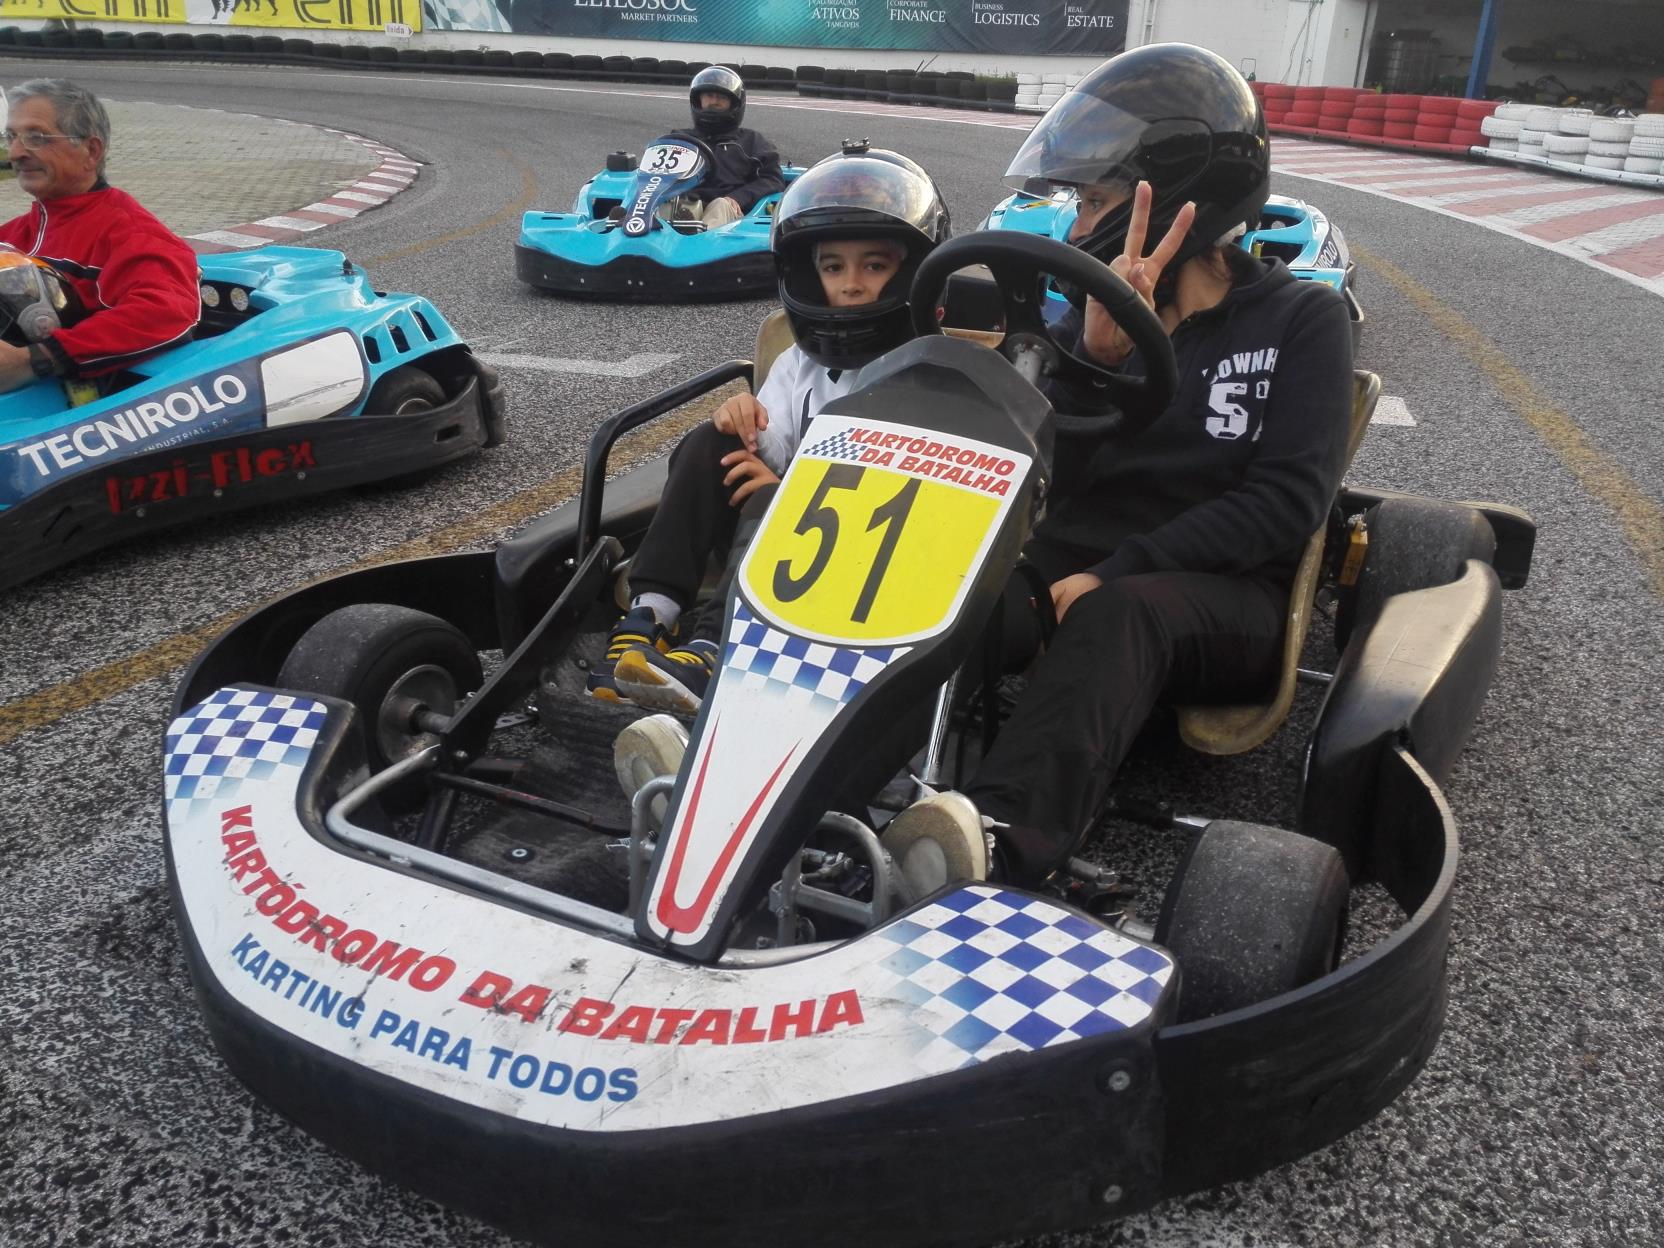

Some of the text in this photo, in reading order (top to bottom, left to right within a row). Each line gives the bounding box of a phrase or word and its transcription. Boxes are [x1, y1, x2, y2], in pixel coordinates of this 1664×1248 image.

[621, 12, 698, 23] MARKET PARTNERS
[812, 8, 860, 20] ATIVOS
[889, 9, 946, 23] FINANCE
[974, 12, 1040, 26] LOGISTICS
[1067, 15, 1115, 28] ESTATE
[652, 148, 682, 169] 35
[18, 374, 248, 478] TECNIROLO
[848, 427, 1016, 476] KARTÓDROMO
[858, 448, 1012, 497] DA BATALHA
[772, 462, 922, 624] 51
[221, 804, 865, 1046] KARTÓDROMO DA BATALHA
[231, 932, 639, 1103] KARTING PARA TODOS
